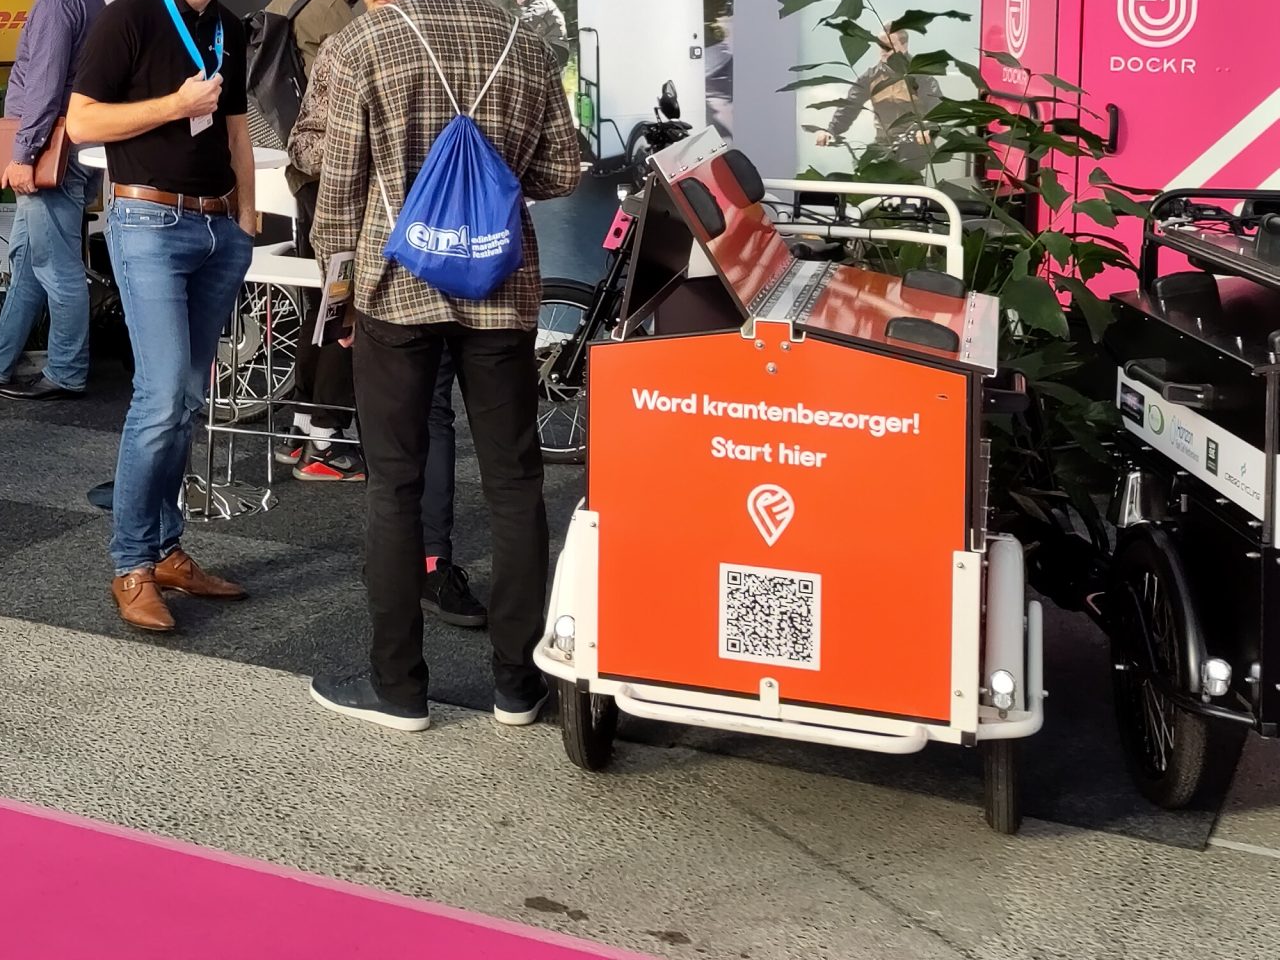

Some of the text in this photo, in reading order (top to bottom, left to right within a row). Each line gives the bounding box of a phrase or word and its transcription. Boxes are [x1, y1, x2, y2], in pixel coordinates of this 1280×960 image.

[1110, 56, 1196, 74] DOCKR
[471, 229, 510, 244] edinburgh
[472, 238, 510, 251] marathon
[473, 247, 502, 259] festival
[632, 388, 920, 437] Word krantenbezorger!
[711, 436, 827, 467] Start hier
